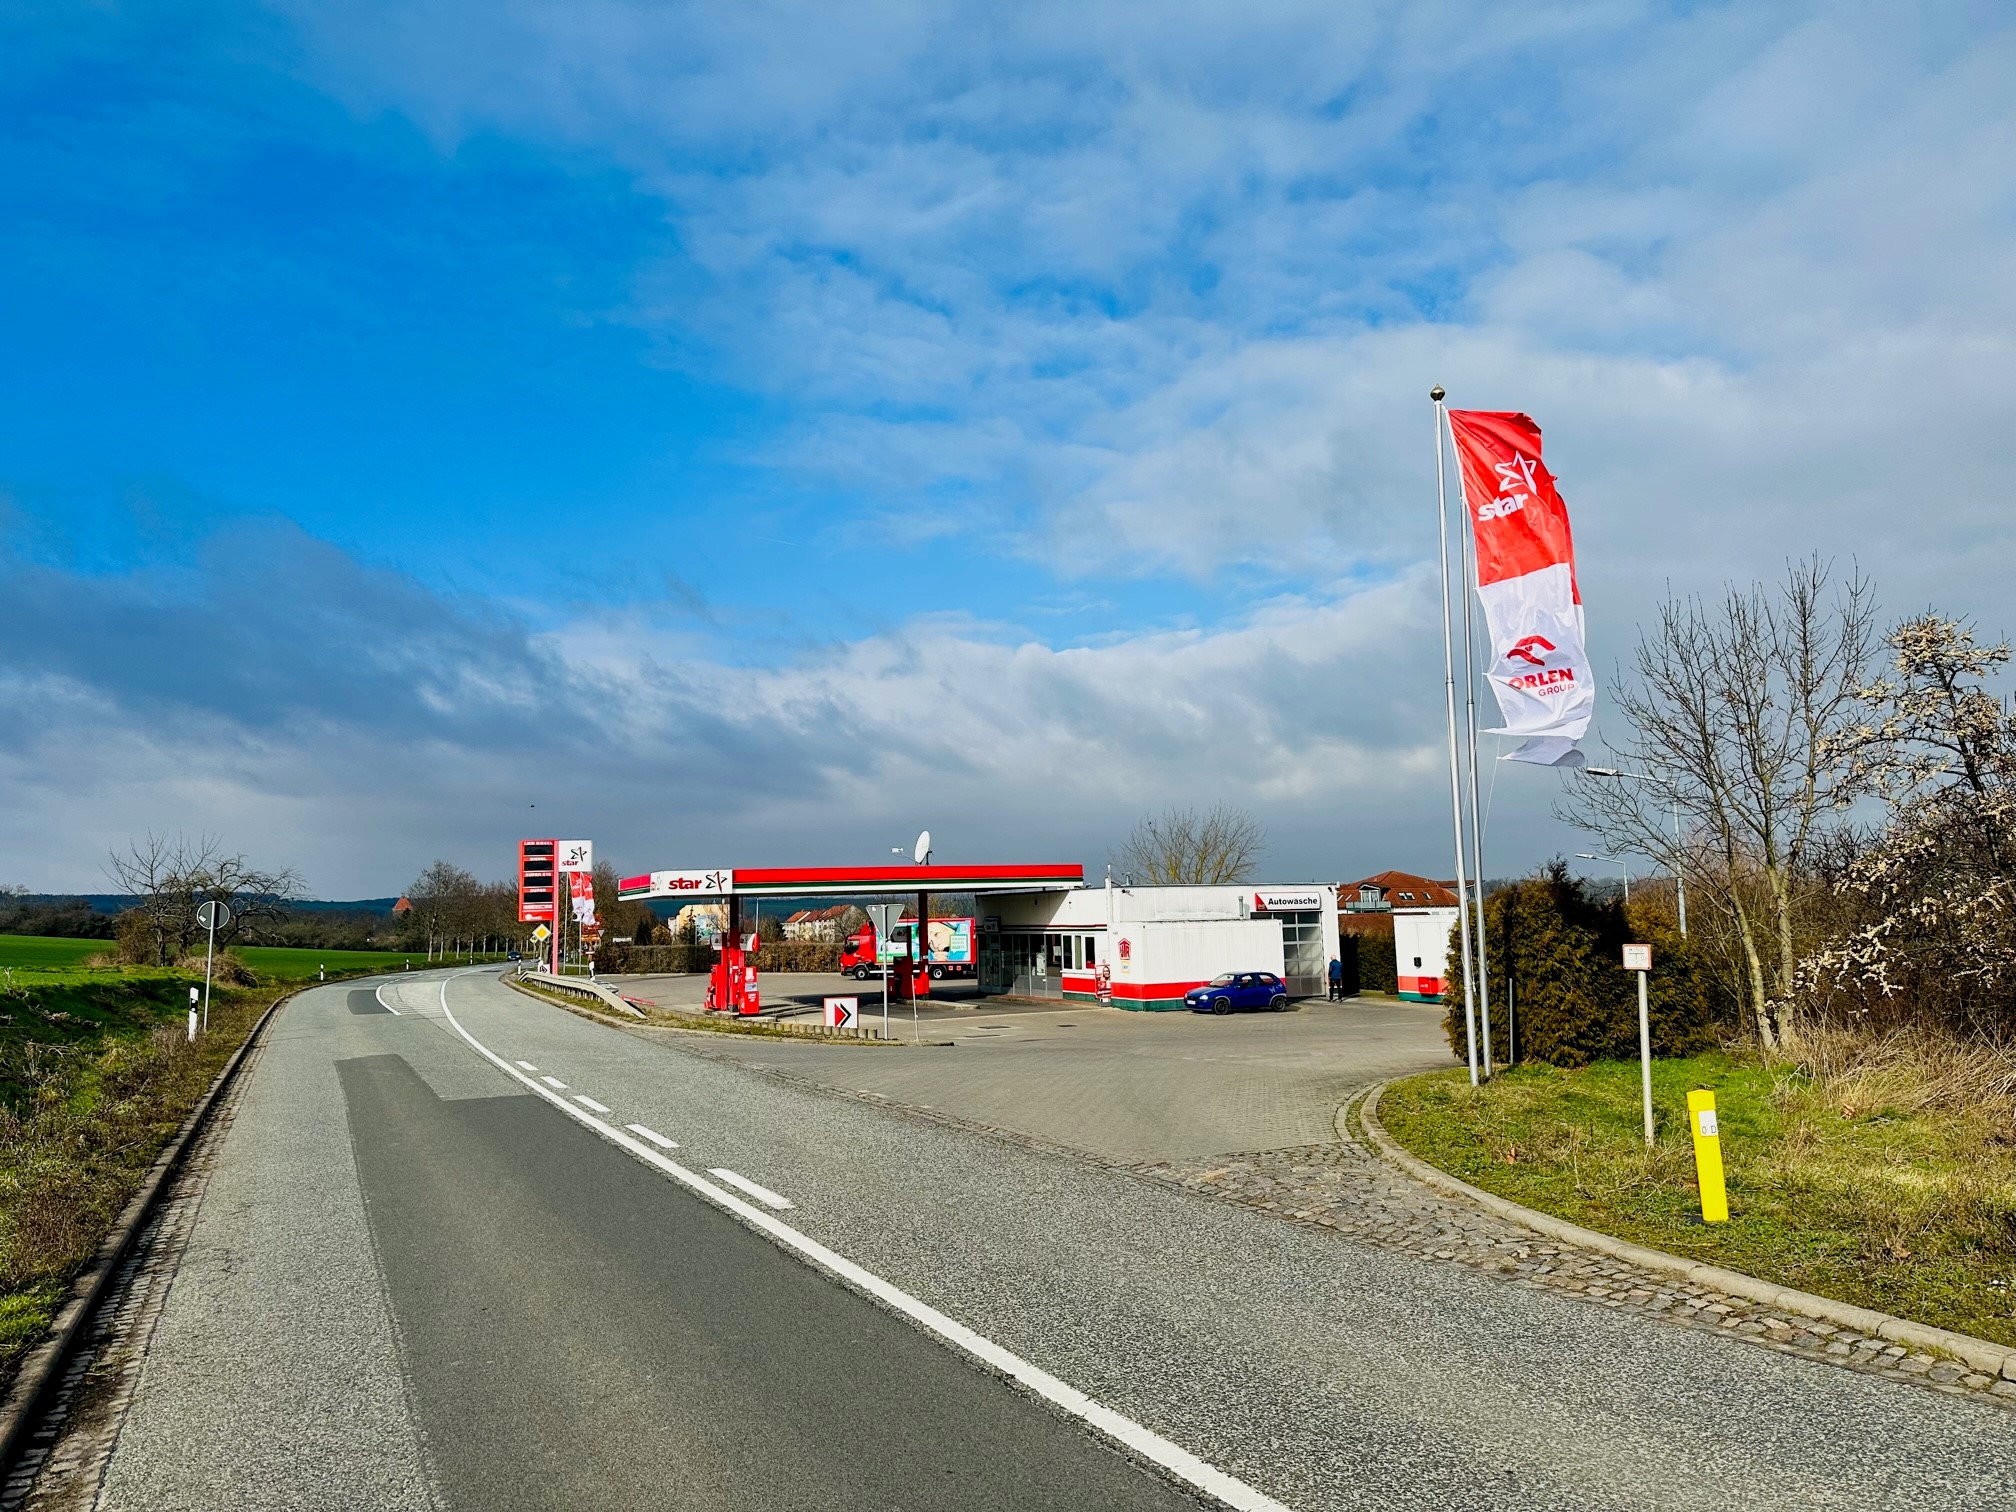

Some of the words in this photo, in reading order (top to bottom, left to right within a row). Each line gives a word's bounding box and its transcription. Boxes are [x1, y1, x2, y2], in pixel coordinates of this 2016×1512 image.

[1478, 493, 1529, 521] star
[1509, 668, 1574, 689] ORLEN
[1538, 683, 1575, 696] GROUP
[668, 877, 702, 890] star
